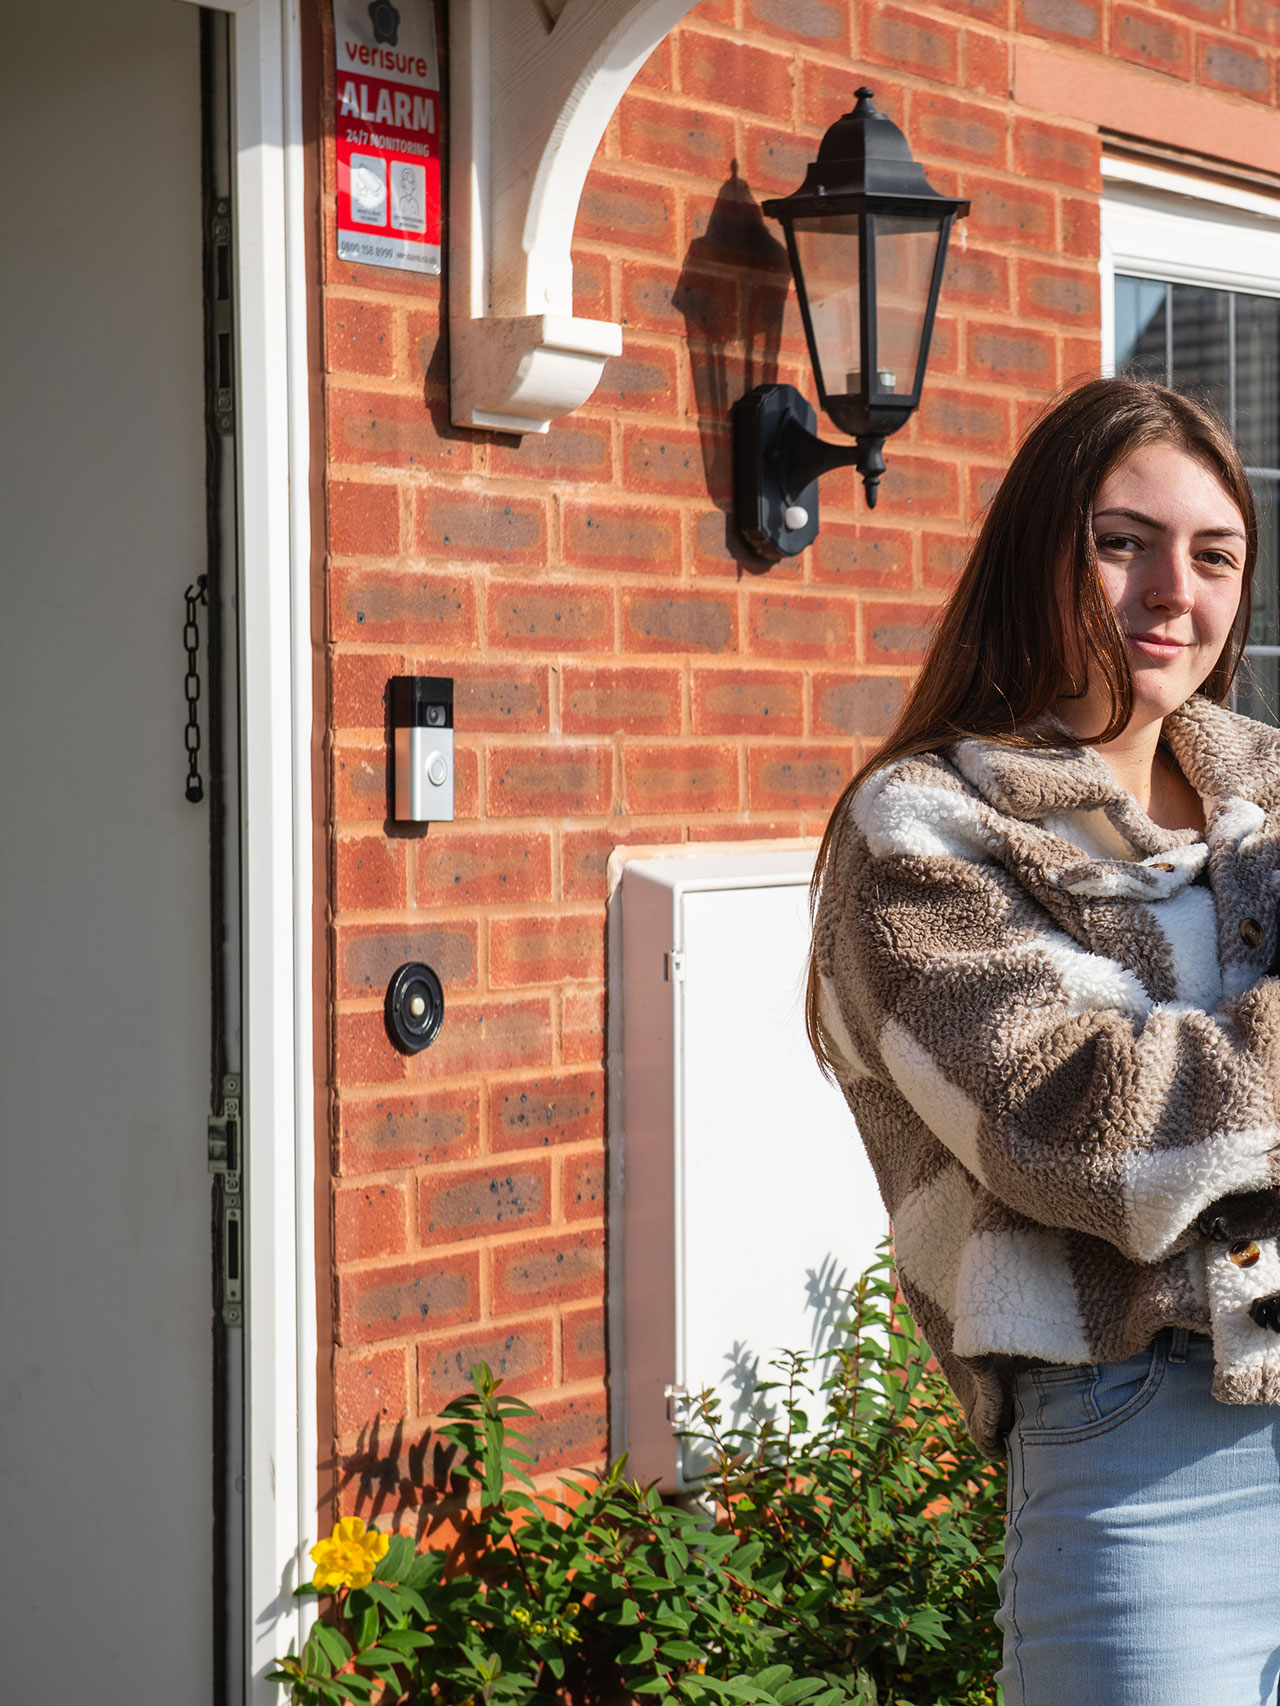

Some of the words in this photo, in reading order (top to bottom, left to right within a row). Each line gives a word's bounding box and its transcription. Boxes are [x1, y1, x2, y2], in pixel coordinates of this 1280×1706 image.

[345, 41, 427, 78] verisure
[341, 80, 435, 134] ALARM
[346, 129, 368, 146] 24/7
[370, 133, 430, 158] MONITORING
